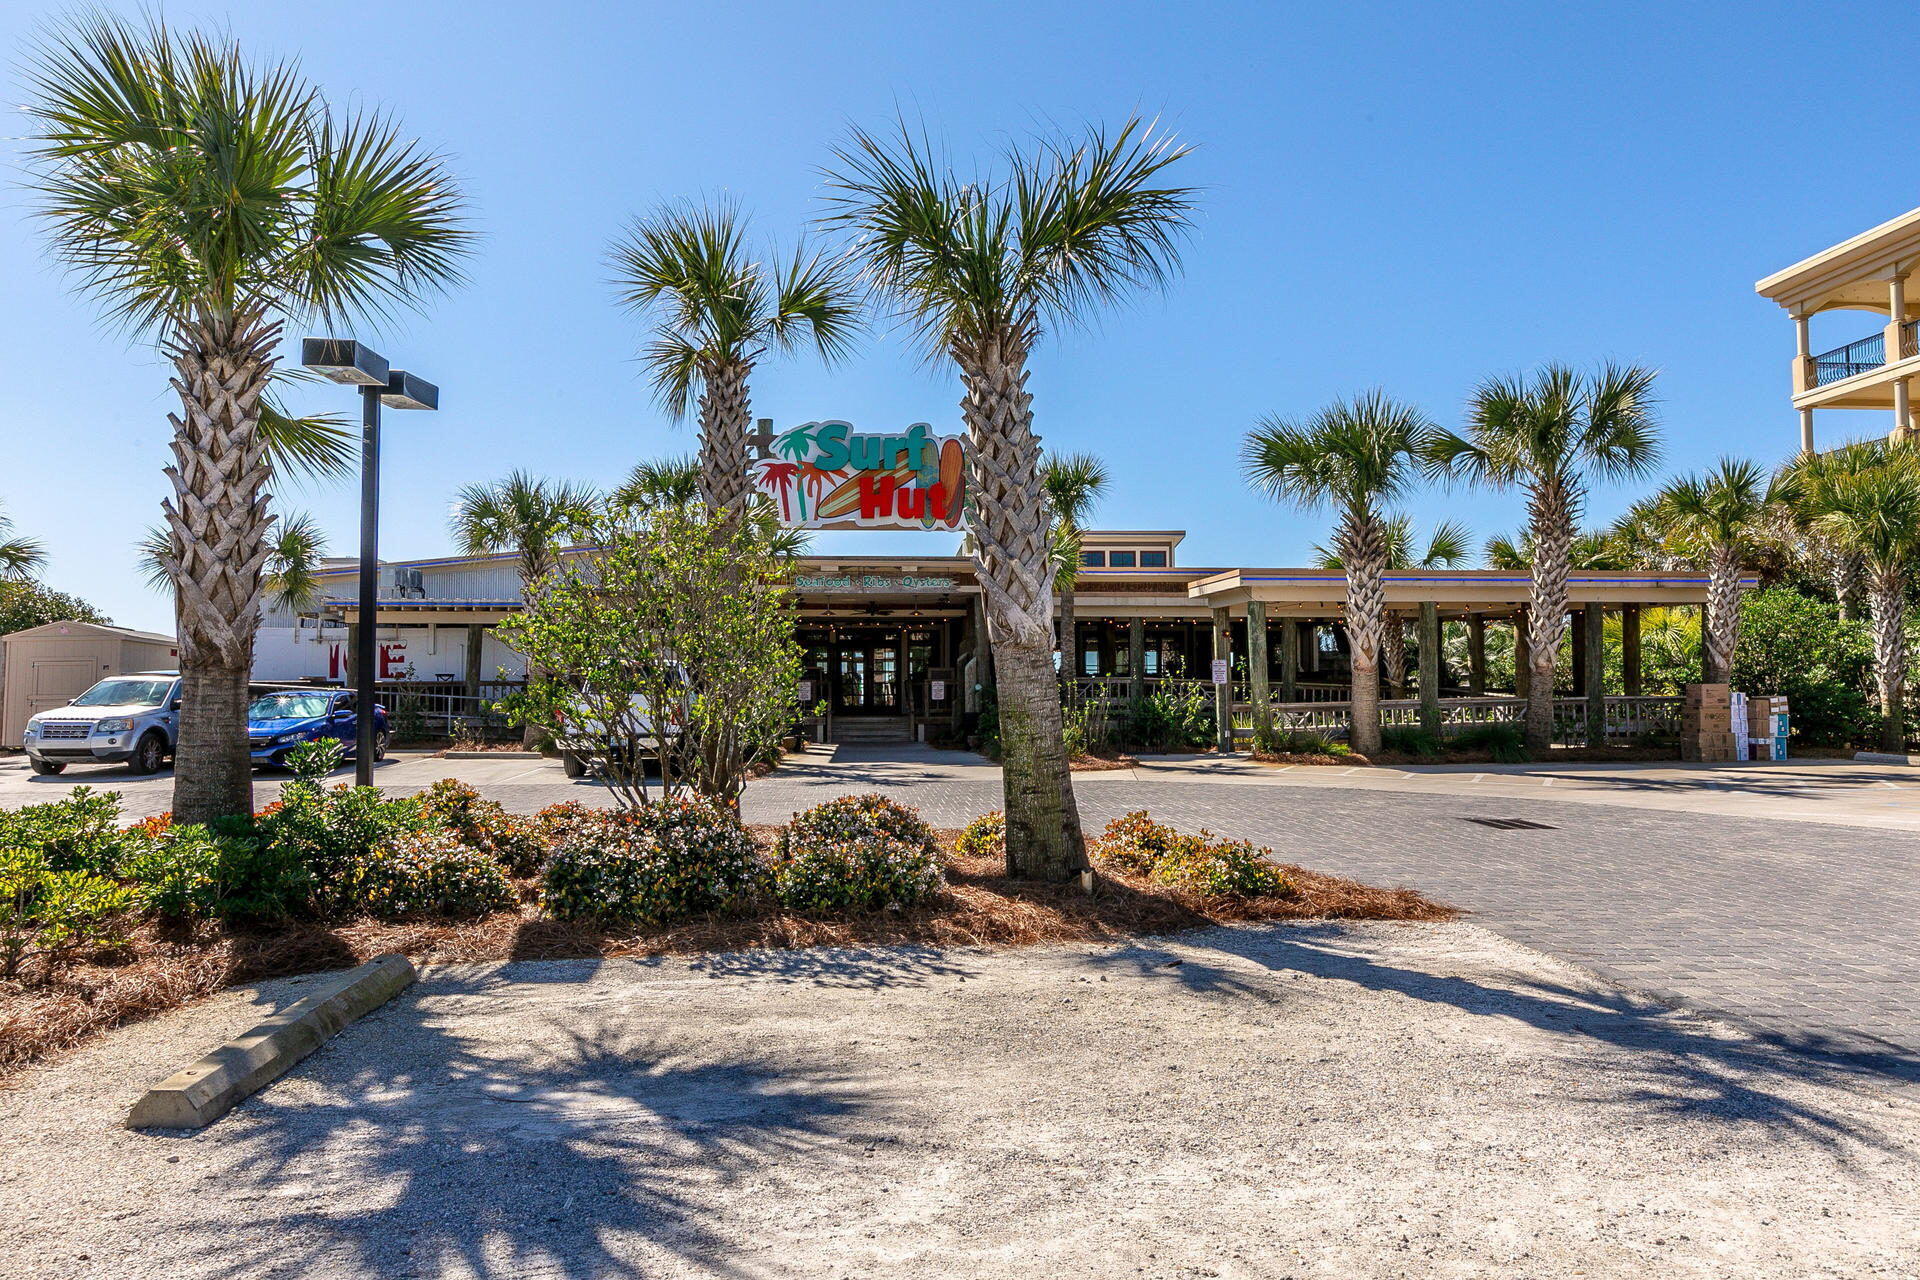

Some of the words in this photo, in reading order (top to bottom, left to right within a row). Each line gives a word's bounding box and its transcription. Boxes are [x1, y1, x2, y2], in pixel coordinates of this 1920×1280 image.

[815, 424, 926, 470] Surf
[859, 476, 947, 519] Hut
[796, 575, 851, 587] Seafood
[863, 576, 891, 587] Ribs
[902, 576, 951, 589] Oysters
[329, 642, 407, 679] IE
